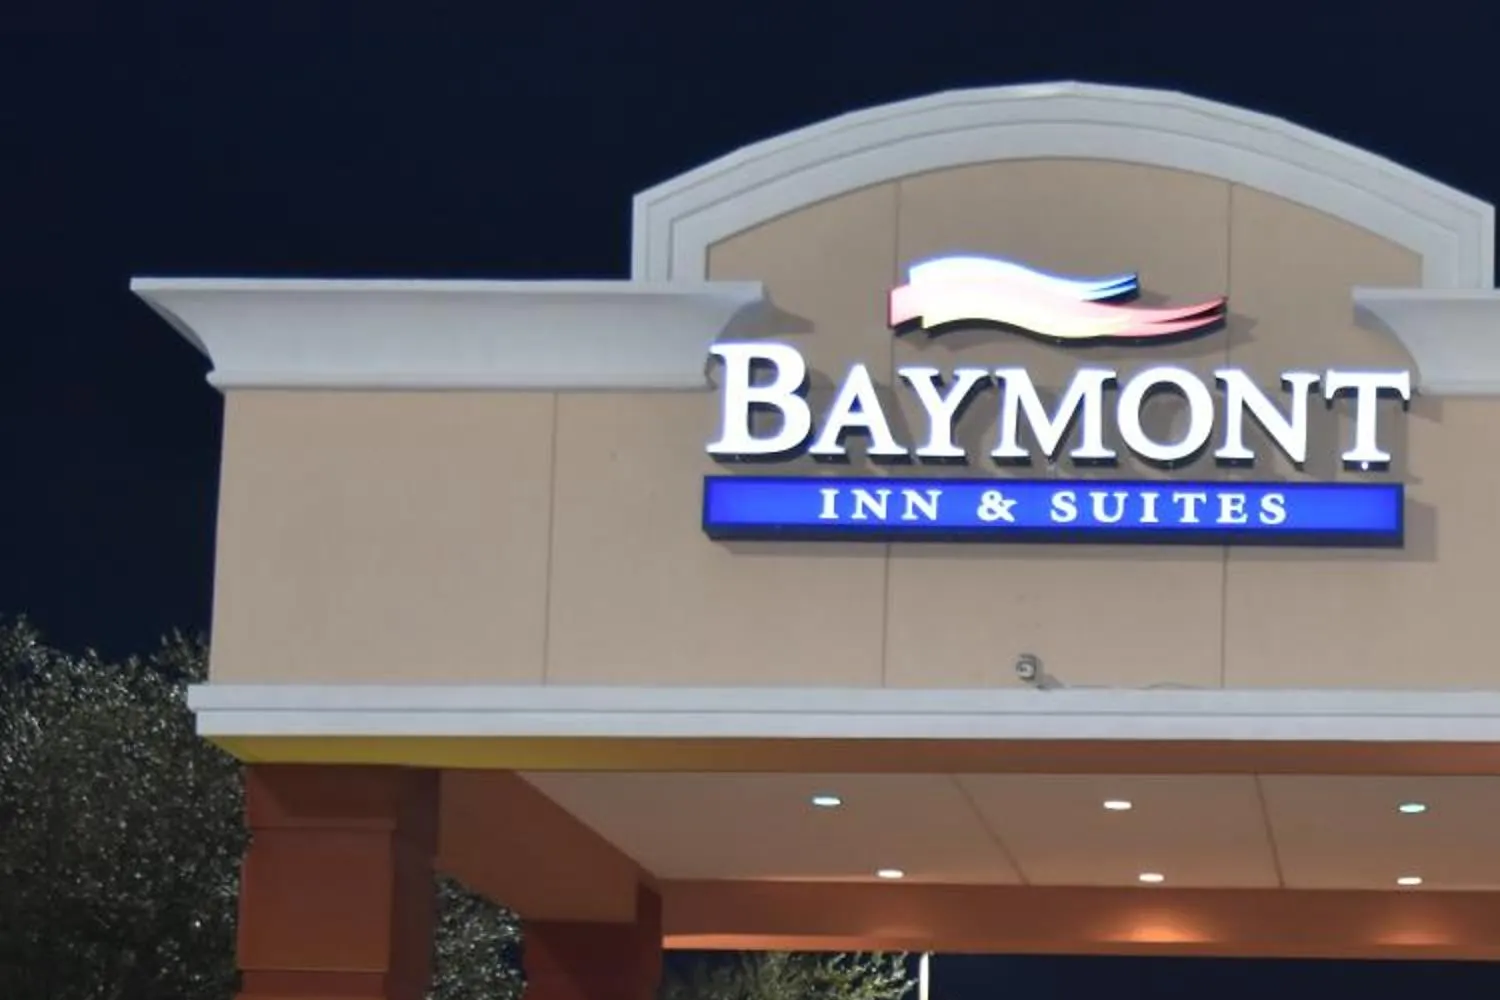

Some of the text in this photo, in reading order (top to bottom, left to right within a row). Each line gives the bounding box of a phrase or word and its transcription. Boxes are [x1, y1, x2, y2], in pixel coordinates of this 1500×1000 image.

[705, 342, 1411, 463] BAYMONT
[818, 487, 1287, 526] INN & SUITES
